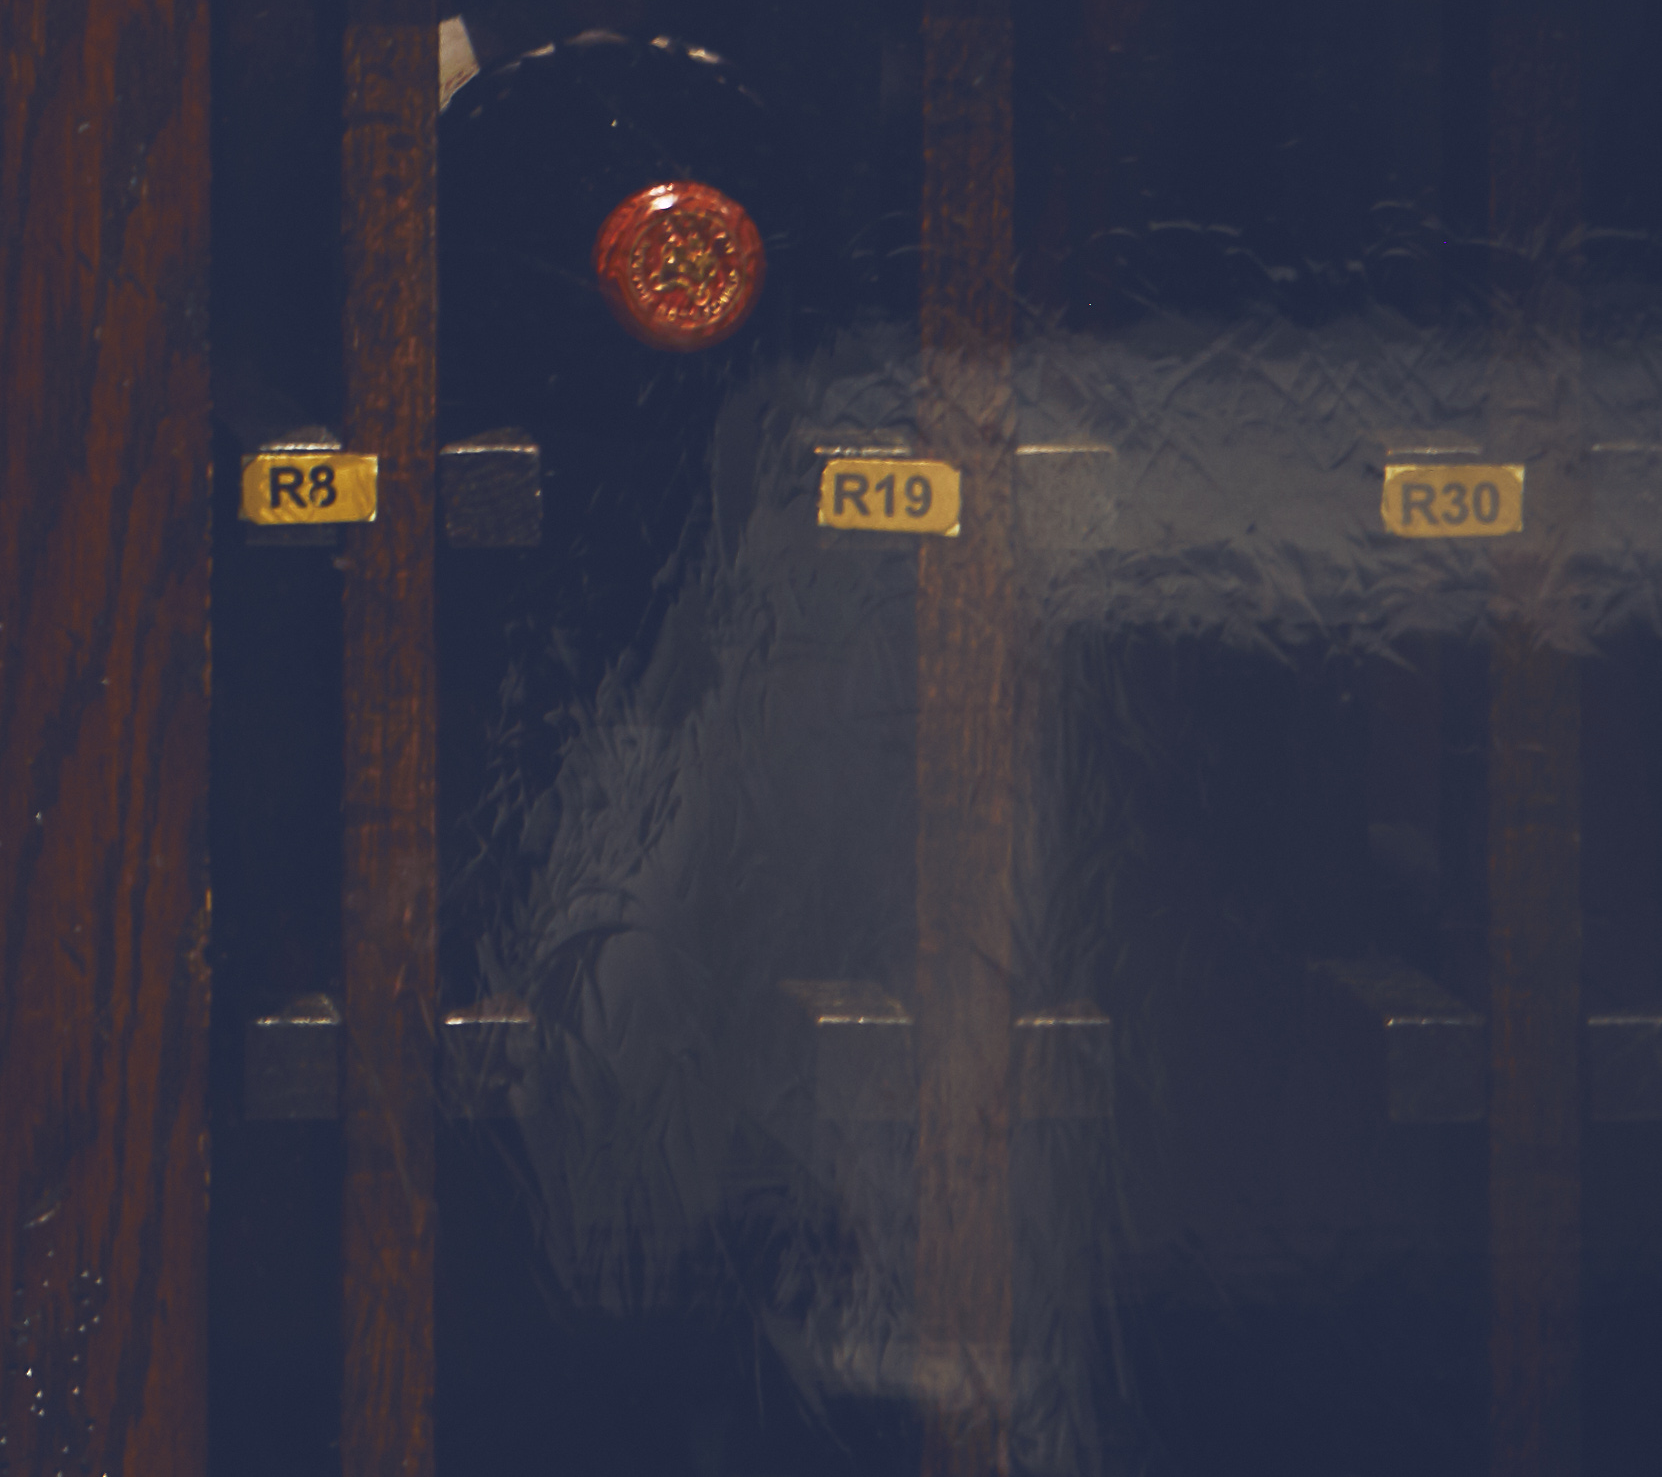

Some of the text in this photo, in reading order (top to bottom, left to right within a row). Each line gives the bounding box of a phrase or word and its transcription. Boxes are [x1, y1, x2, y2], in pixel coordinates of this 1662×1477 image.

[270, 464, 336, 508] R8
[834, 473, 931, 517] R19
[1402, 481, 1500, 525] R30
